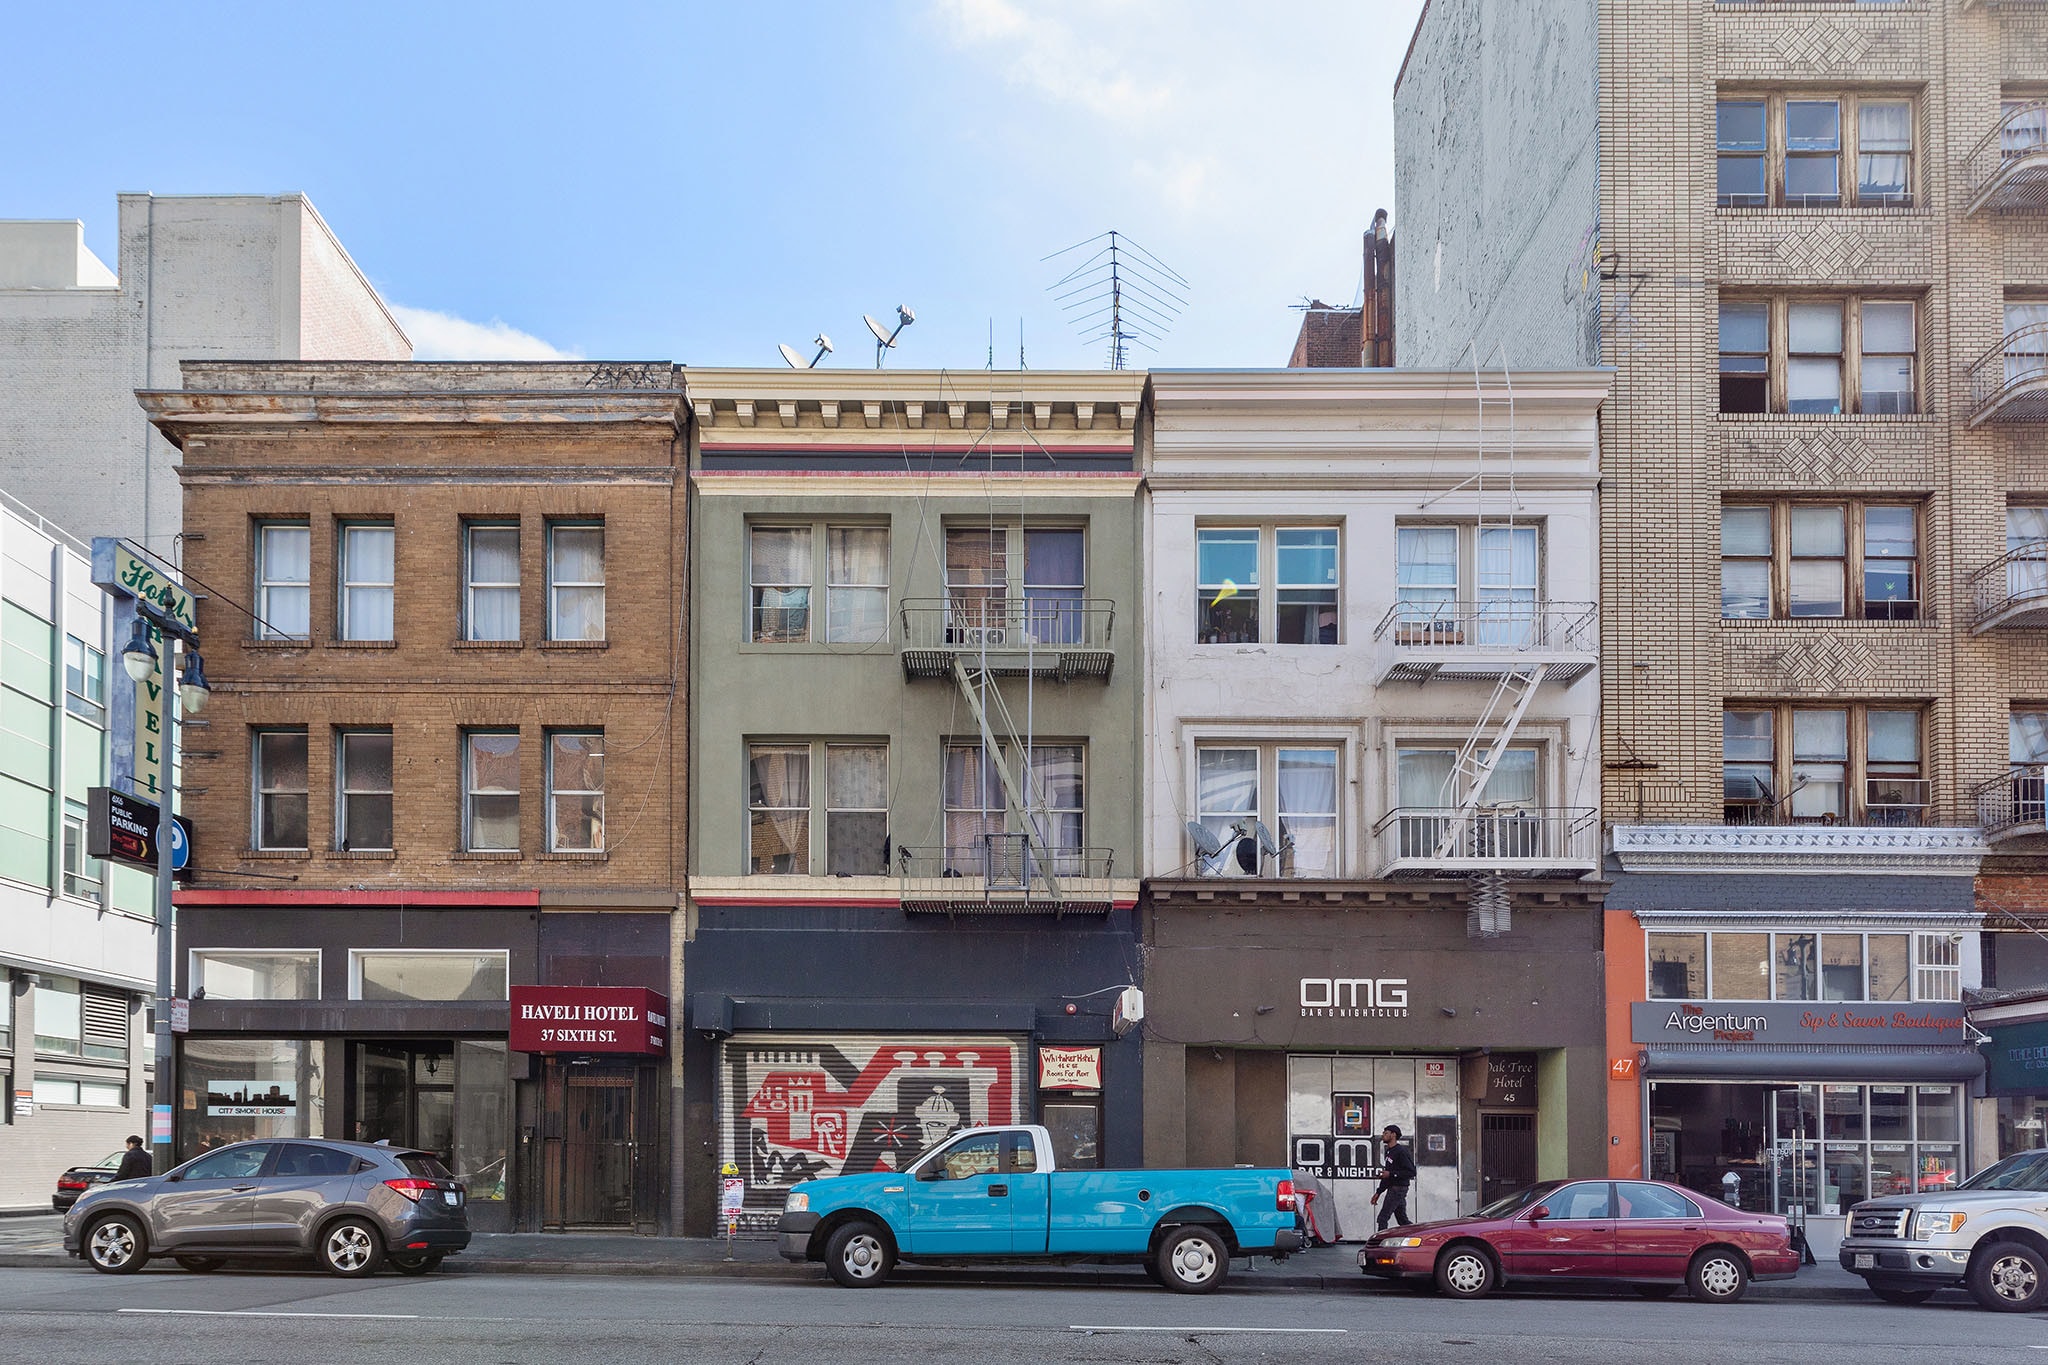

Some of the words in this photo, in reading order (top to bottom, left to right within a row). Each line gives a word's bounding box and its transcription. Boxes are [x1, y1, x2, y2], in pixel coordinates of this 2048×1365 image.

[121, 559, 186, 617] Hotl
[111, 805, 133, 820] PUBLIC
[111, 815, 148, 837] PARKING
[521, 1004, 582, 1020] HAVELI
[583, 1006, 639, 1021] HOTEL
[1301, 1008, 1323, 1017] BAR
[1340, 1008, 1407, 1018] NIGHTCLUB
[1680, 1004, 1704, 1015] The
[1664, 1011, 1768, 1033] Argentum
[1799, 1011, 1824, 1034] Sip
[1827, 1014, 1839, 1028] &
[1842, 1011, 1888, 1029] Savor
[1891, 1012, 1964, 1035] Boutique
[541, 1029, 555, 1042] 37
[556, 1030, 597, 1042] SIXTH
[598, 1030, 618, 1042] ST.
[1713, 1030, 1755, 1042] Project
[1429, 1063, 1441, 1071] NO
[1507, 1060, 1532, 1073] Tree
[1612, 1059, 1633, 1073] 47
[1493, 1074, 1525, 1088] Hotel
[1503, 1093, 1515, 1102] 45
[235, 1107, 260, 1115] SMOKE
[262, 1107, 286, 1115] HOUSE
[1327, 1167, 1332, 1177] &
